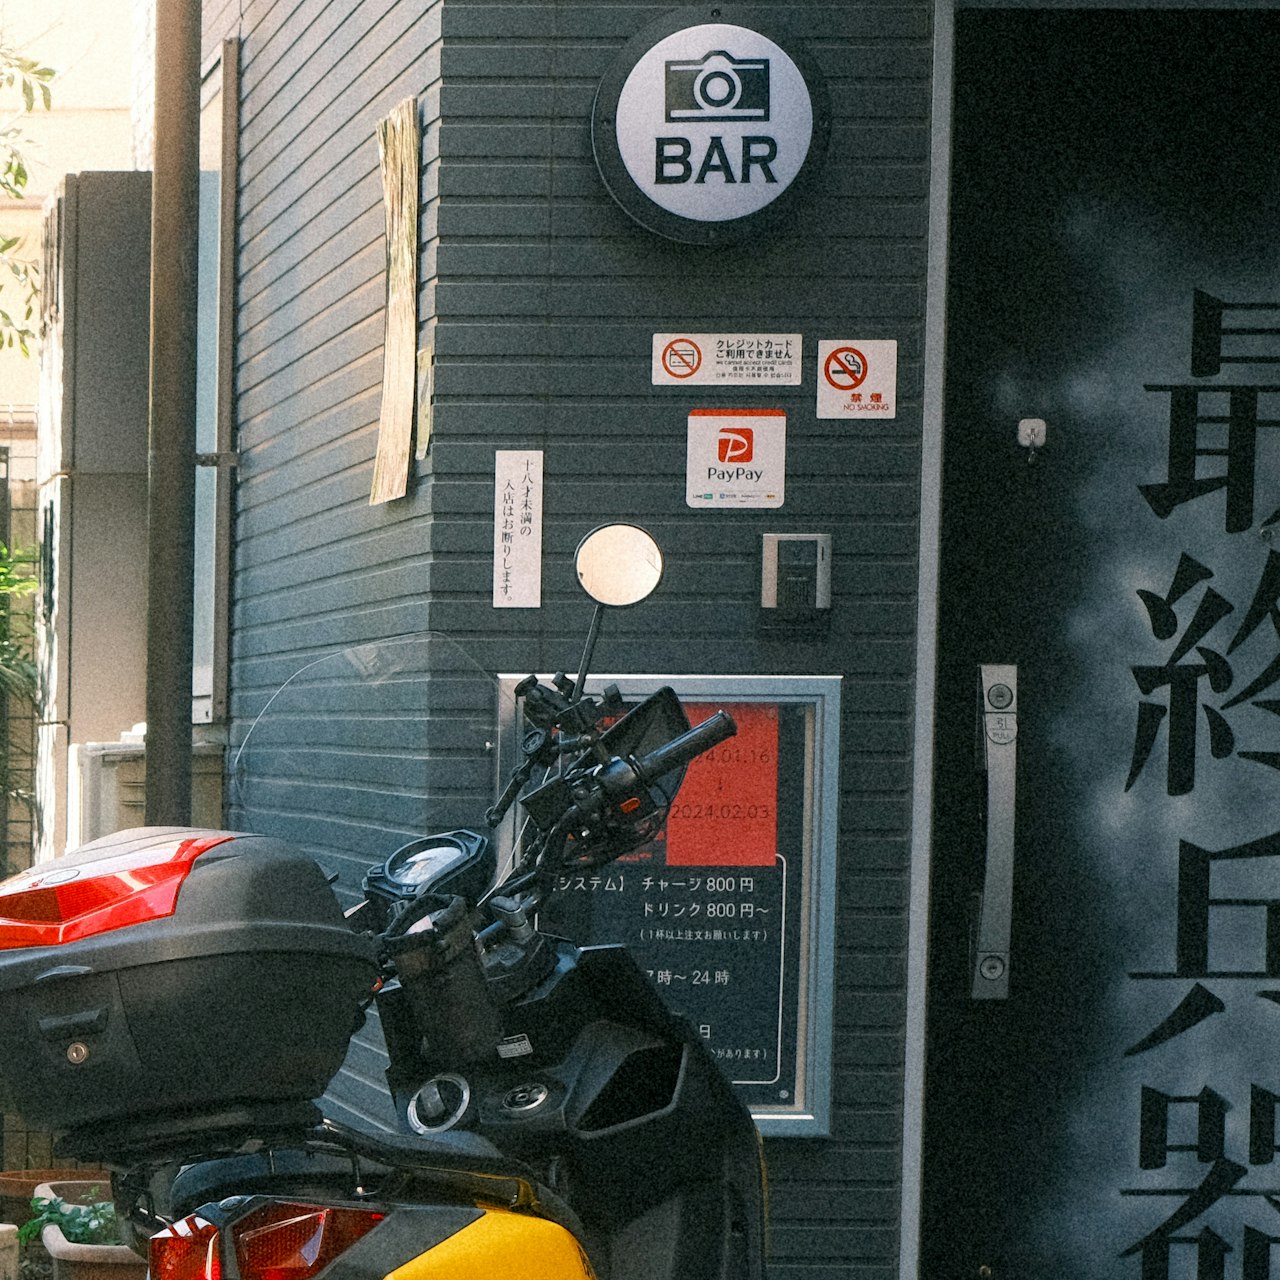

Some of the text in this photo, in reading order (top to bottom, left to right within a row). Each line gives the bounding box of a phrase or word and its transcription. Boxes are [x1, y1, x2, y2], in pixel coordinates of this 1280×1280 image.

[654, 135, 778, 184] BAR
[716, 339, 793, 349] クレジットカード
[716, 349, 793, 359] ご利用できません
[843, 403, 889, 411] NO SMOKING
[707, 467, 764, 483] PayPay
[520, 459, 534, 537] 十八才未満の
[671, 804, 770, 819] 2024.02.03
